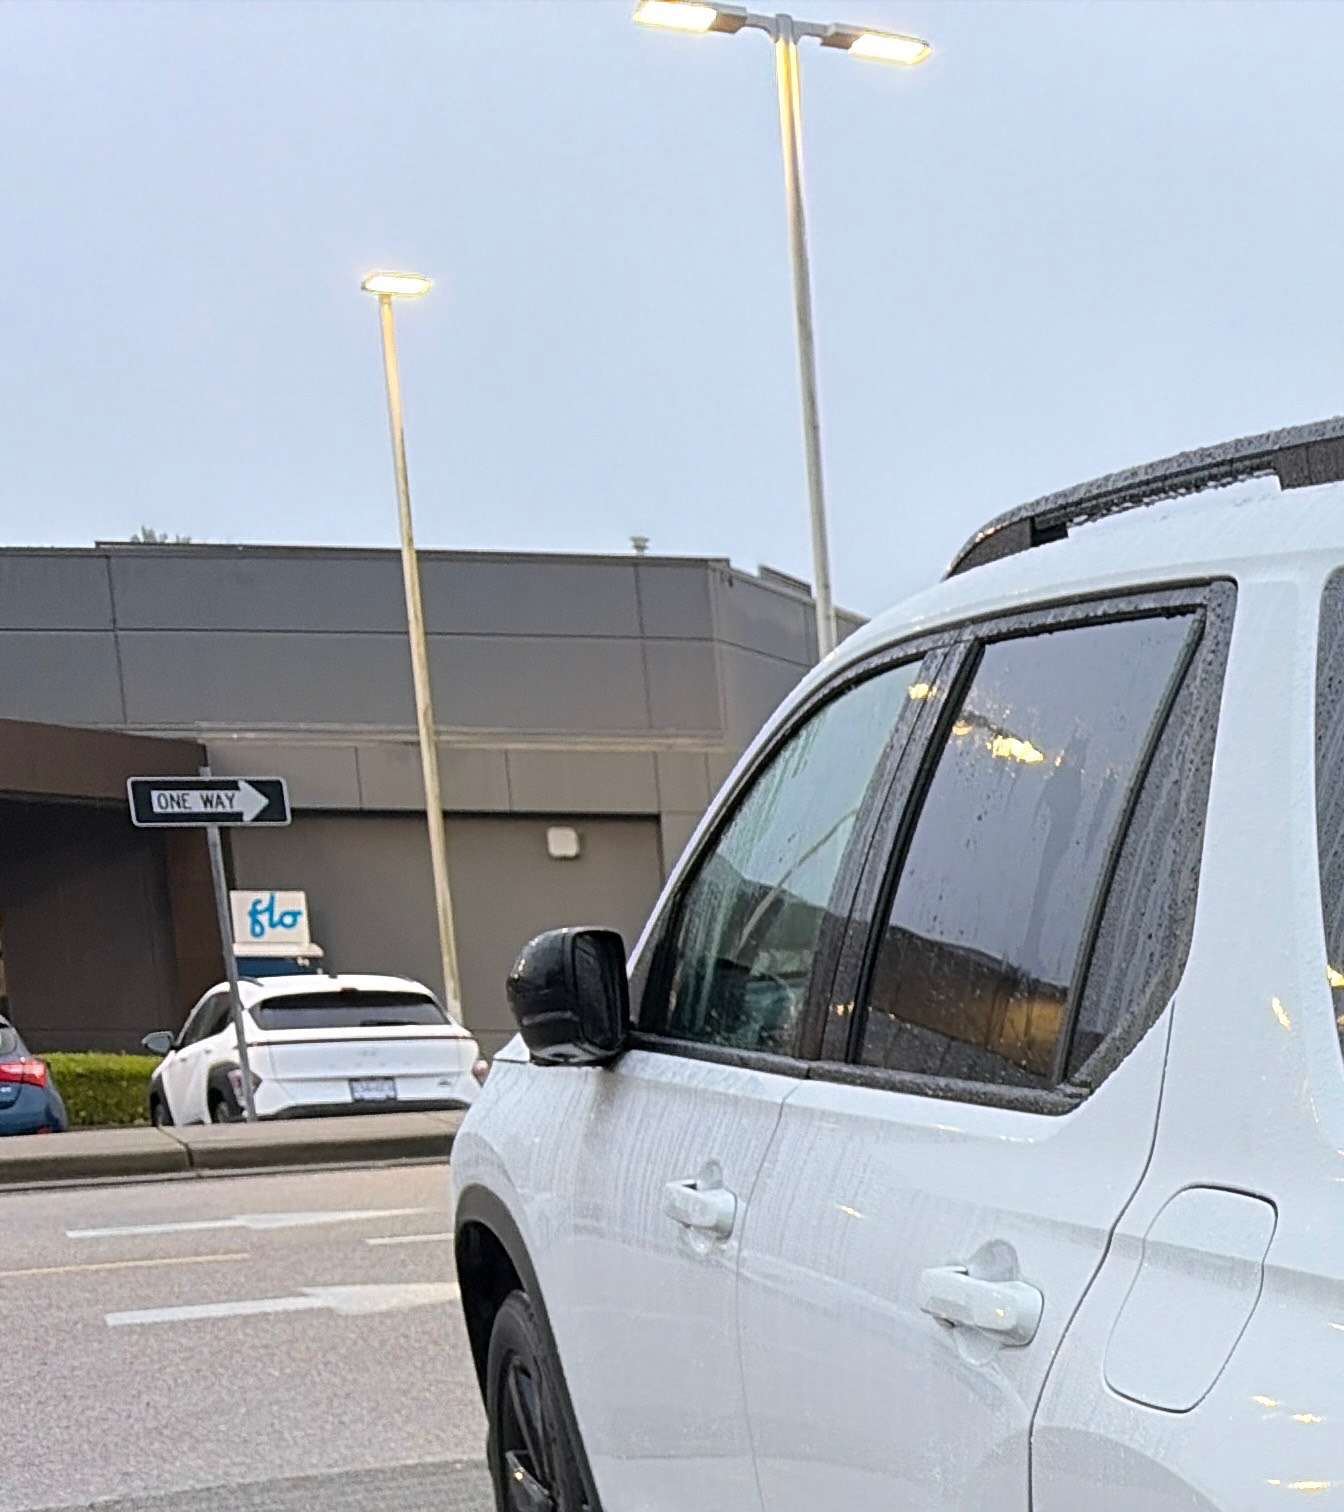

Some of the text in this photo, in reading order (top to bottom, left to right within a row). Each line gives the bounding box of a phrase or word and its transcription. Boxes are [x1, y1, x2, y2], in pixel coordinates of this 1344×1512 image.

[156, 792, 236, 810] ONE WAY
[248, 894, 302, 938] flo
